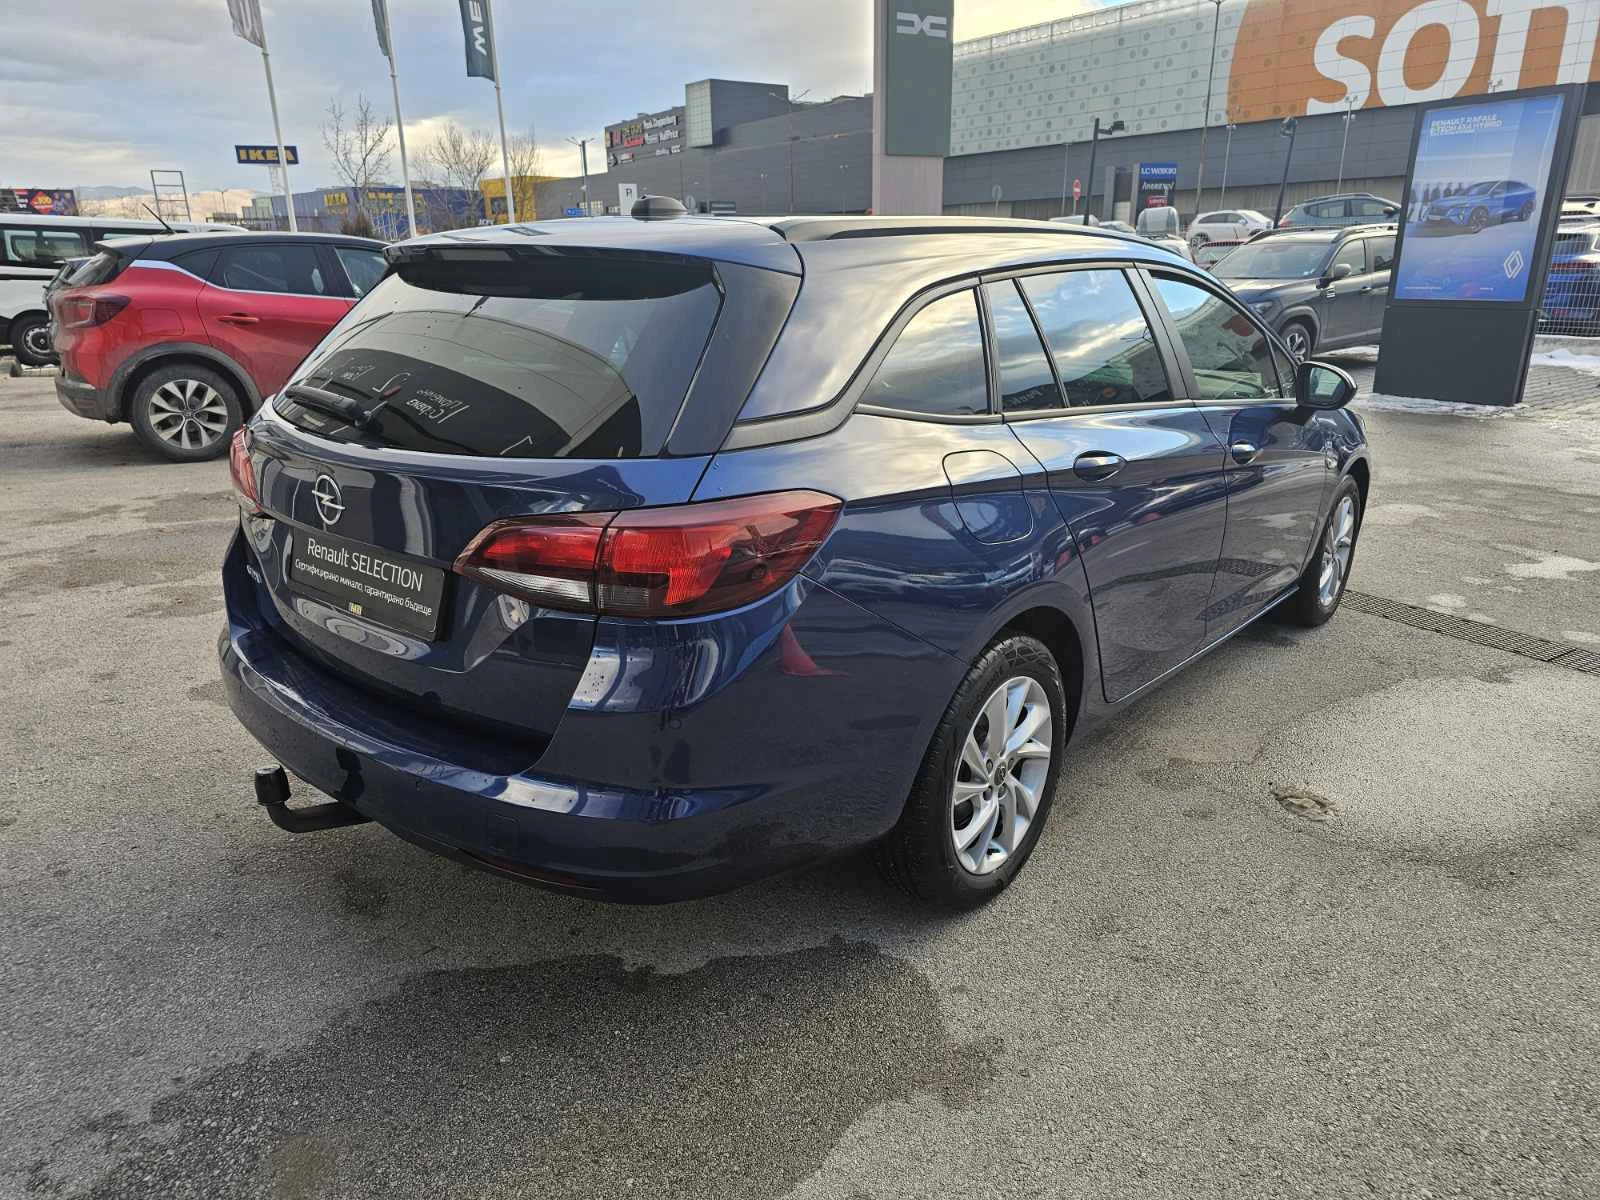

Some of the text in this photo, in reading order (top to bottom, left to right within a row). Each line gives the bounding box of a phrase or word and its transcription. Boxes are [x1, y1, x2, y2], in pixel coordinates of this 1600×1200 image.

[239, 149, 295, 161] IKEA
[307, 538, 423, 592] Renault SELECTION
